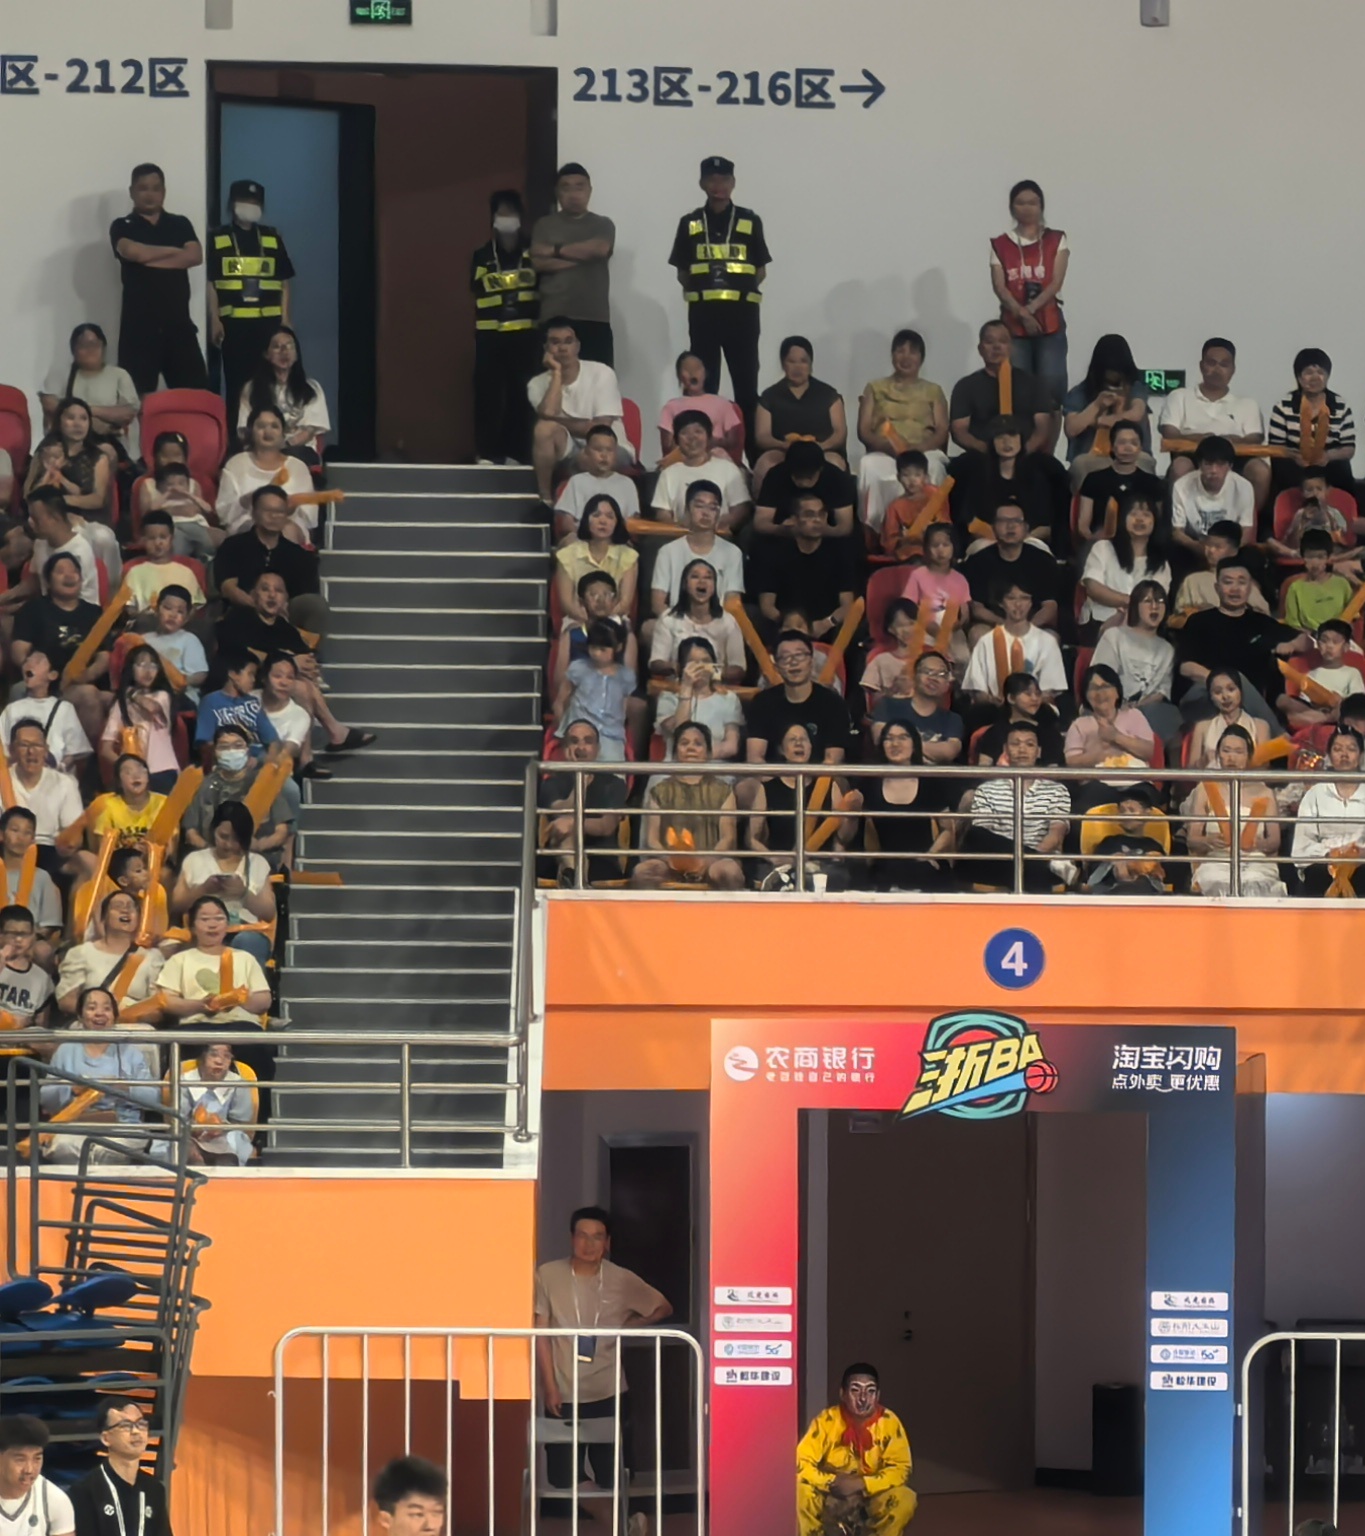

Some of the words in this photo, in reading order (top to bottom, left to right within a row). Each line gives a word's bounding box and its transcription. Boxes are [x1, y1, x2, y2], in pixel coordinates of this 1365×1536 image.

[573, 66, 836, 109] 213区-216区
[1001, 941, 1028, 977] 4
[765, 1046, 875, 1070] 农商银行
[1112, 1044, 1222, 1071] 淘宝闪购
